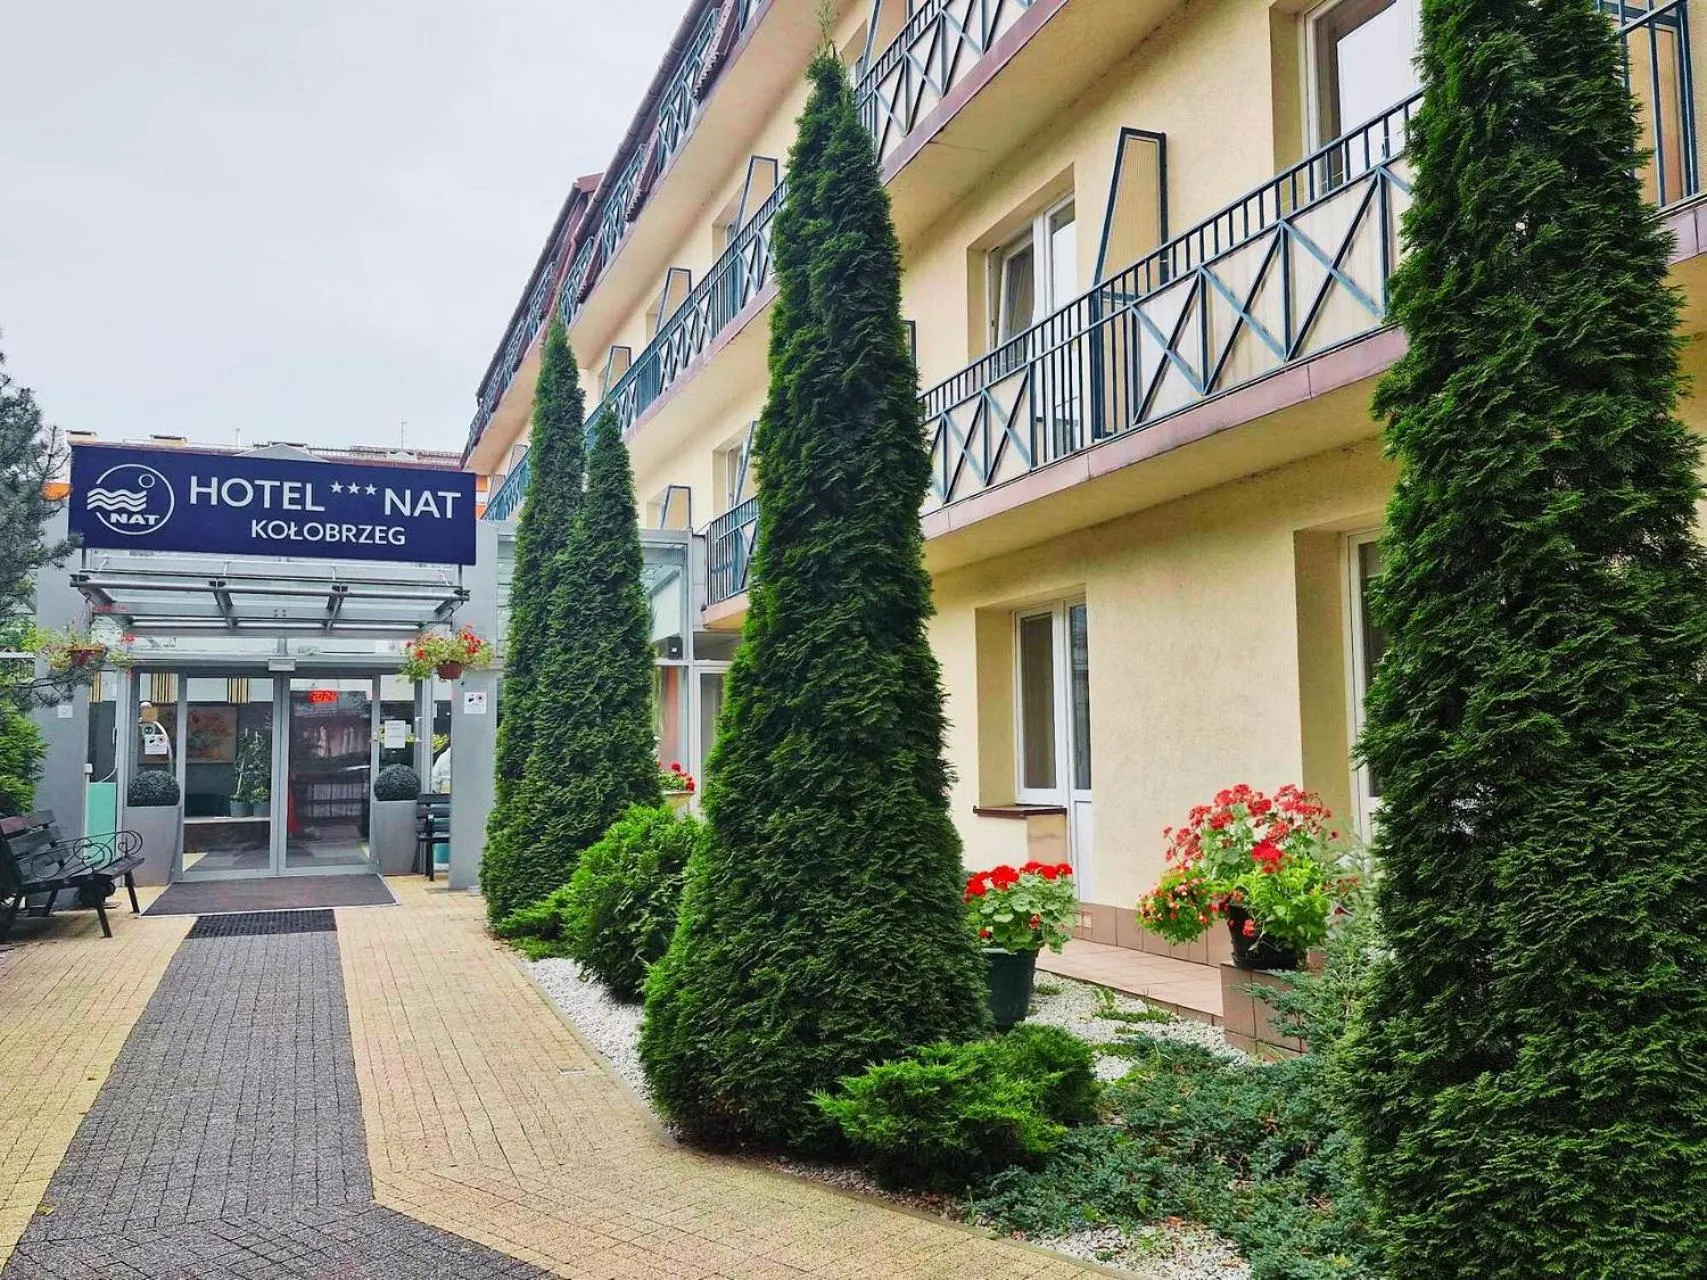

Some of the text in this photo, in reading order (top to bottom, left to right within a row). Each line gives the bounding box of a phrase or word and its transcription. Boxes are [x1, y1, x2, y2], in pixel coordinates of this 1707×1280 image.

[190, 475, 462, 519] HOTEL NAT
[110, 512, 160, 525] NAT
[251, 519, 406, 545] KOŁOBRZEG
